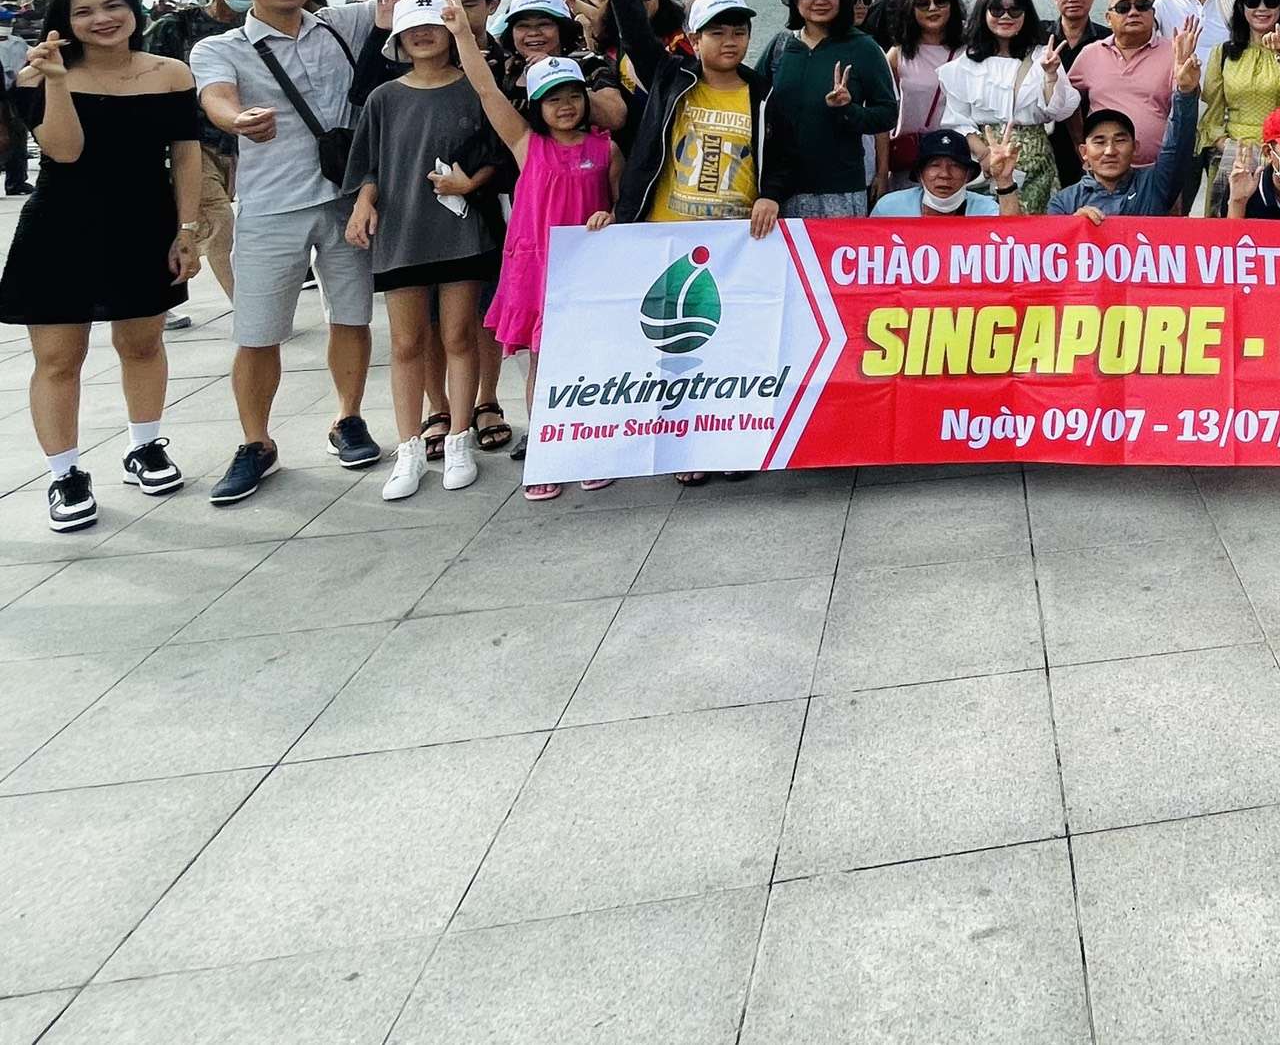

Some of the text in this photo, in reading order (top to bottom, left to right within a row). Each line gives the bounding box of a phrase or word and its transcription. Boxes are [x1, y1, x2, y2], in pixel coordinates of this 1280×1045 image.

[831, 233, 940, 286] CHÀO
[949, 231, 1068, 284] MỪNG
[1075, 232, 1187, 284] ĐOÀN
[862, 305, 1225, 377] SINGAPORE
[547, 365, 792, 411] vietkingtravel
[540, 413, 776, 443] Đi Tour Sướng Như Vua
[940, 406, 1036, 450] Ngày
[1041, 407, 1146, 447] 09/07
